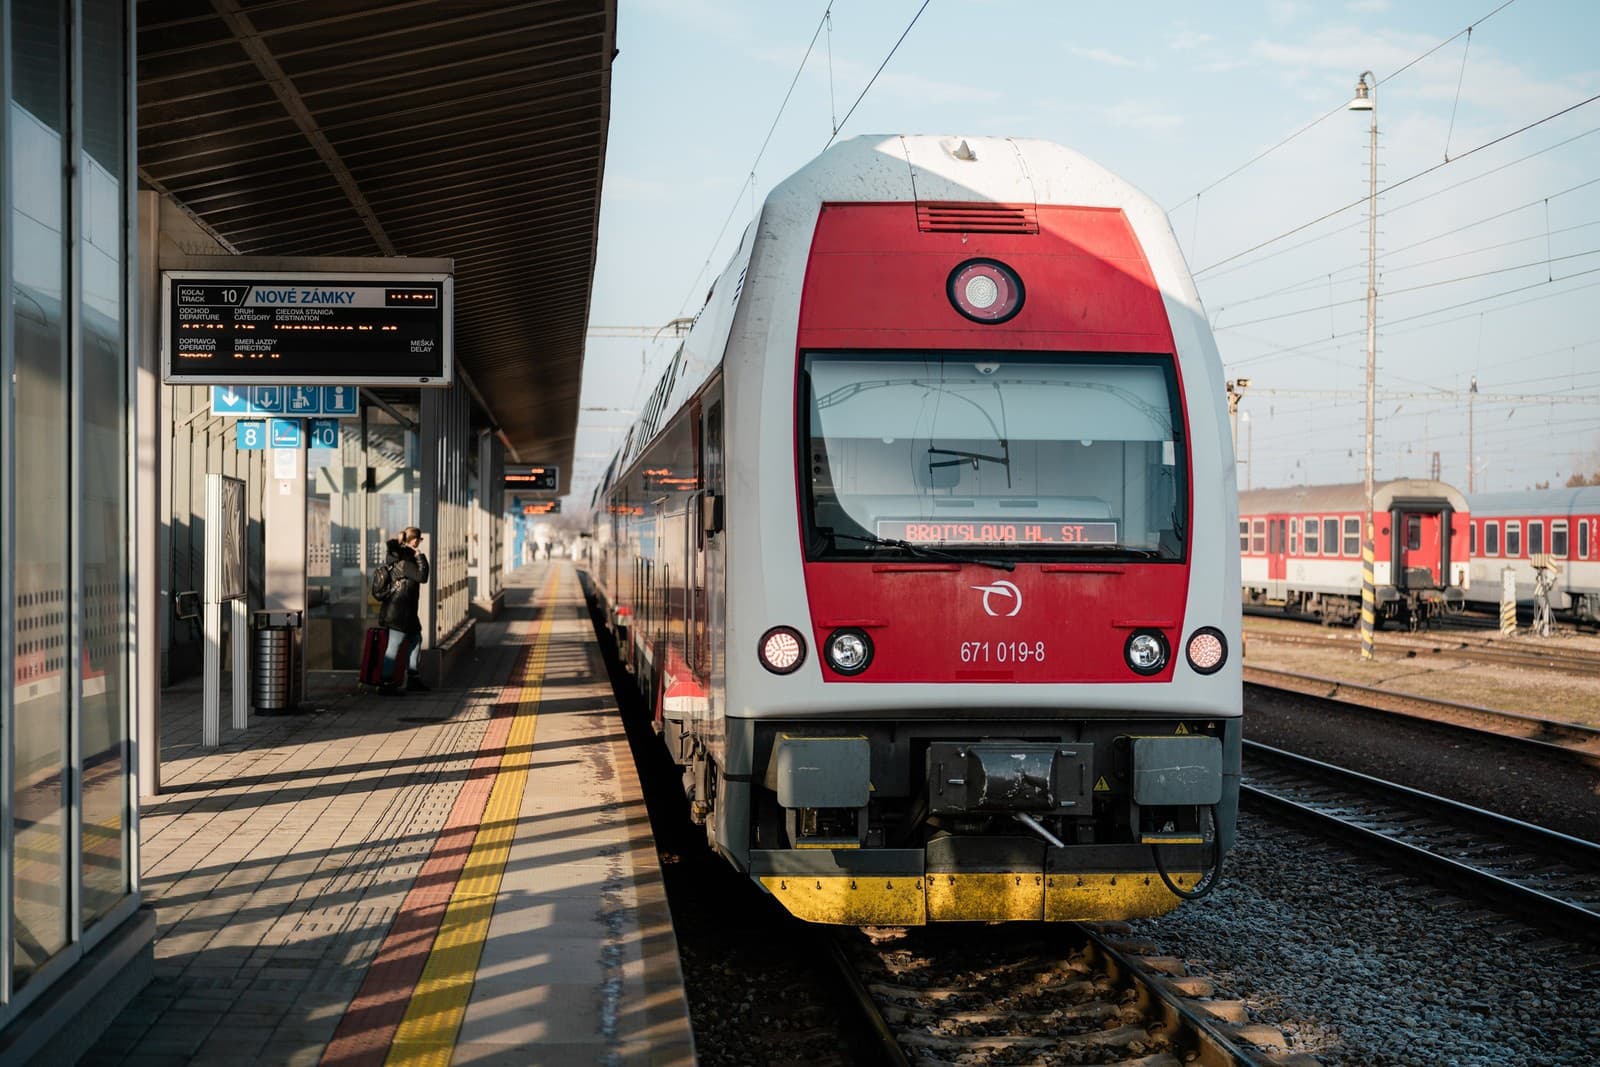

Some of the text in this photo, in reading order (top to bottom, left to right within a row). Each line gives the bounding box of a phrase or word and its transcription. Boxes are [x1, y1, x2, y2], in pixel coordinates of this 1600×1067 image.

[221, 289, 238, 303] 10
[255, 287, 355, 304] NOVÉ ZÁMKY
[244, 428, 257, 446] 8
[313, 428, 334, 446] 10
[906, 524, 1089, 542] BRATISLAVA HL. ST.
[960, 641, 1045, 663] 671 019-8
